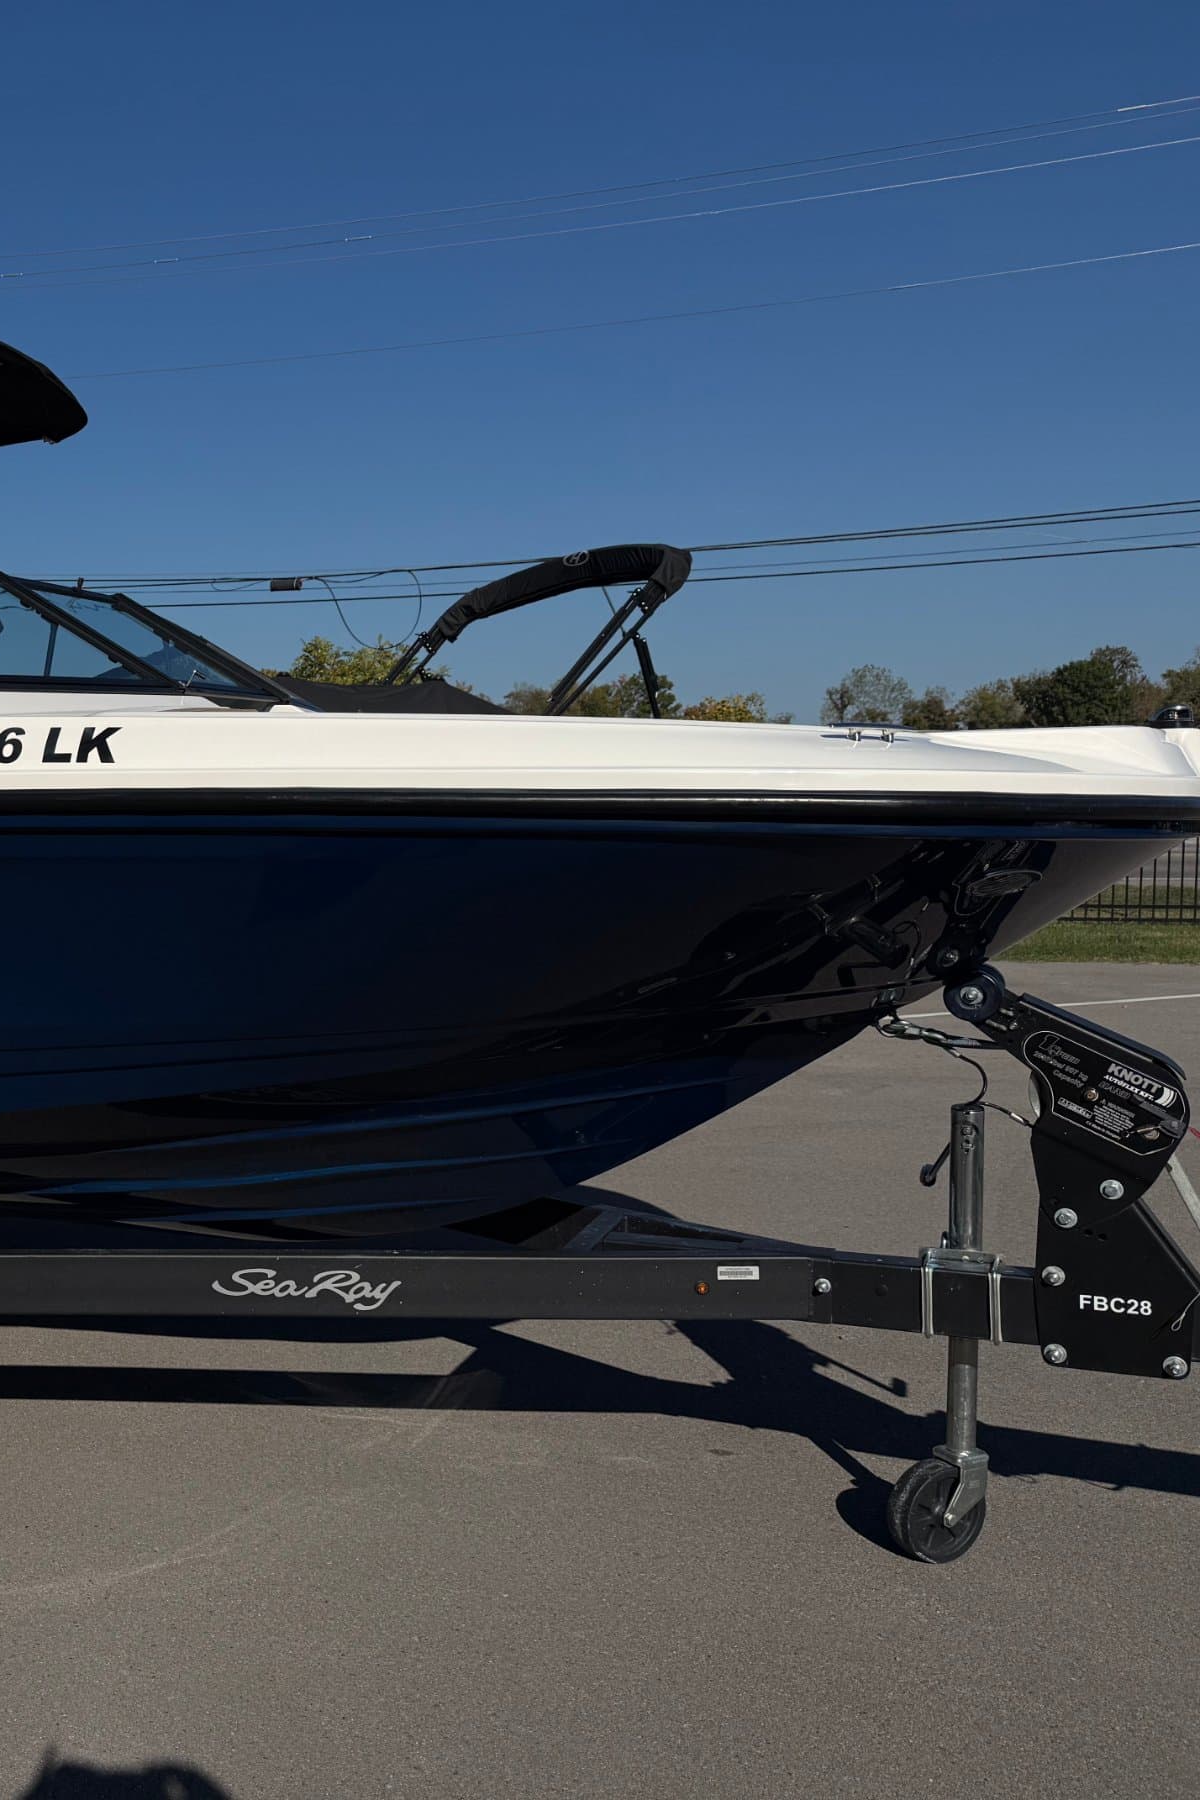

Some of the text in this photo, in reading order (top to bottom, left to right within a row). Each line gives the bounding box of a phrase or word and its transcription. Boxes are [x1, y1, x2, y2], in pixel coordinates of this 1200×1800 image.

[41, 727, 124, 764] LK
[1107, 1062, 1162, 1094] KNOTT
[211, 1268, 402, 1311] Sea Ray
[1079, 1294, 1152, 1316] FBC28
